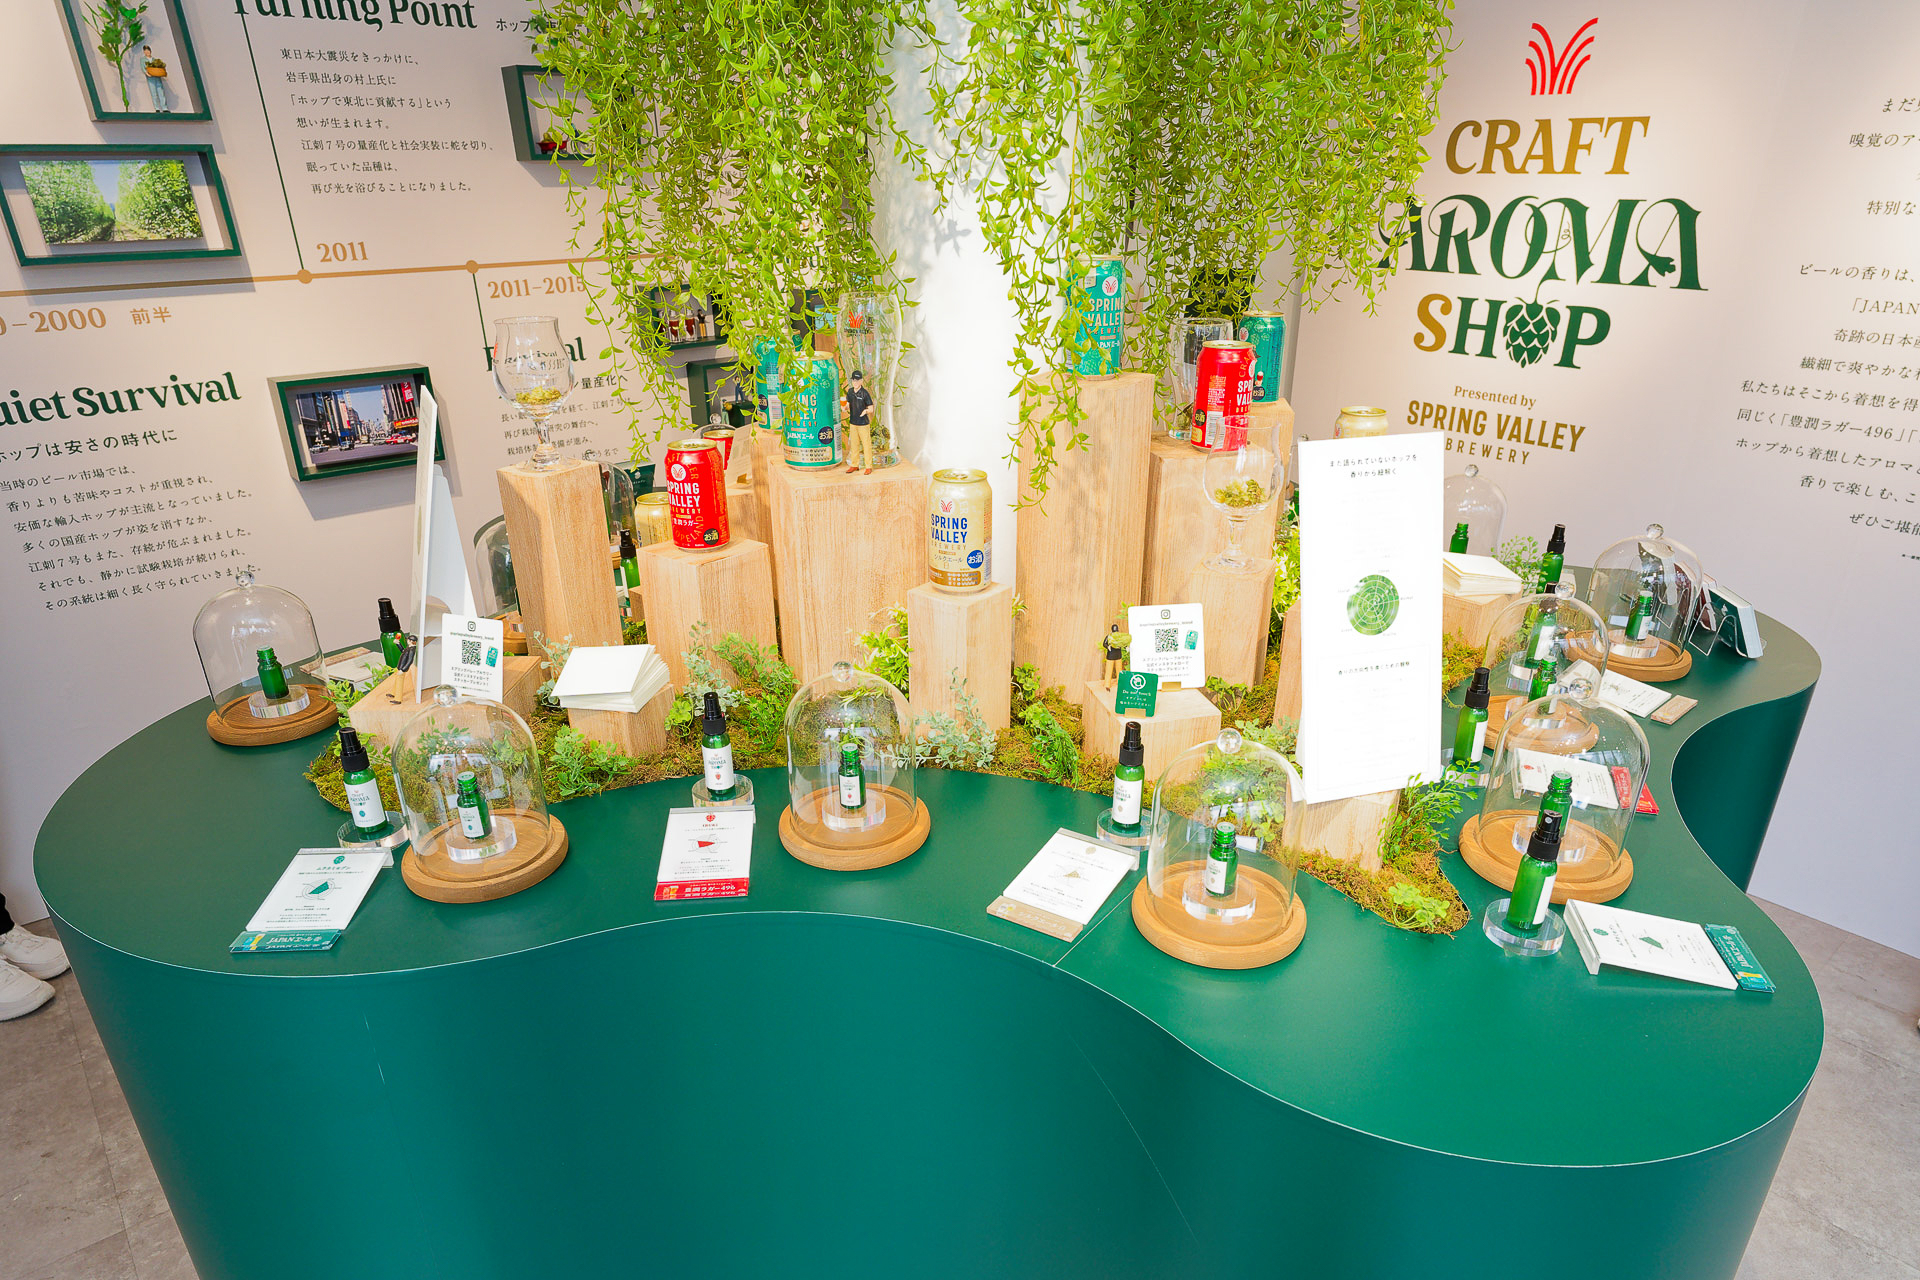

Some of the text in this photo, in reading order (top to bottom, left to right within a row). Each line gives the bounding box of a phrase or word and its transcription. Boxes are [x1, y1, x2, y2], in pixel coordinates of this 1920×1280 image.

[390, 0, 477, 28] Point
[280, 48, 419, 65] 東日本大震災をきっかけに、
[286, 72, 397, 86] 岩手県出身の村上氏に
[290, 93, 452, 109] 「ホップで東北に貢献する」という
[297, 117, 390, 130] 想いが生まれます。
[1446, 116, 1651, 175] CRAFT
[306, 161, 399, 173] 眠っていた品種は、
[311, 181, 472, 194] 再び光を浴びることになりました。
[1377, 194, 1709, 291] AROMA
[317, 242, 369, 263] 2011
[1800, 263, 1916, 283] ビールの香りは、
[130, 306, 172, 325] 前半
[1413, 293, 1611, 370] SHOP
[72, 371, 242, 416] Survival
[1454, 386, 1536, 410] Presented by
[1407, 400, 1586, 452] SPRING VALLEY
[819, 431, 833, 441] お酒
[1445, 437, 1530, 465] BREWERY
[0, 465, 136, 492] 当時のビール市場では、
[667, 480, 700, 495] SPRING
[6, 475, 213, 513] 香りよりも苦味やコストが重視され、
[931, 513, 967, 529] SPRING
[704, 530, 719, 541] お酒
[931, 527, 967, 543] VALLEY
[967, 552, 983, 564] お酒
